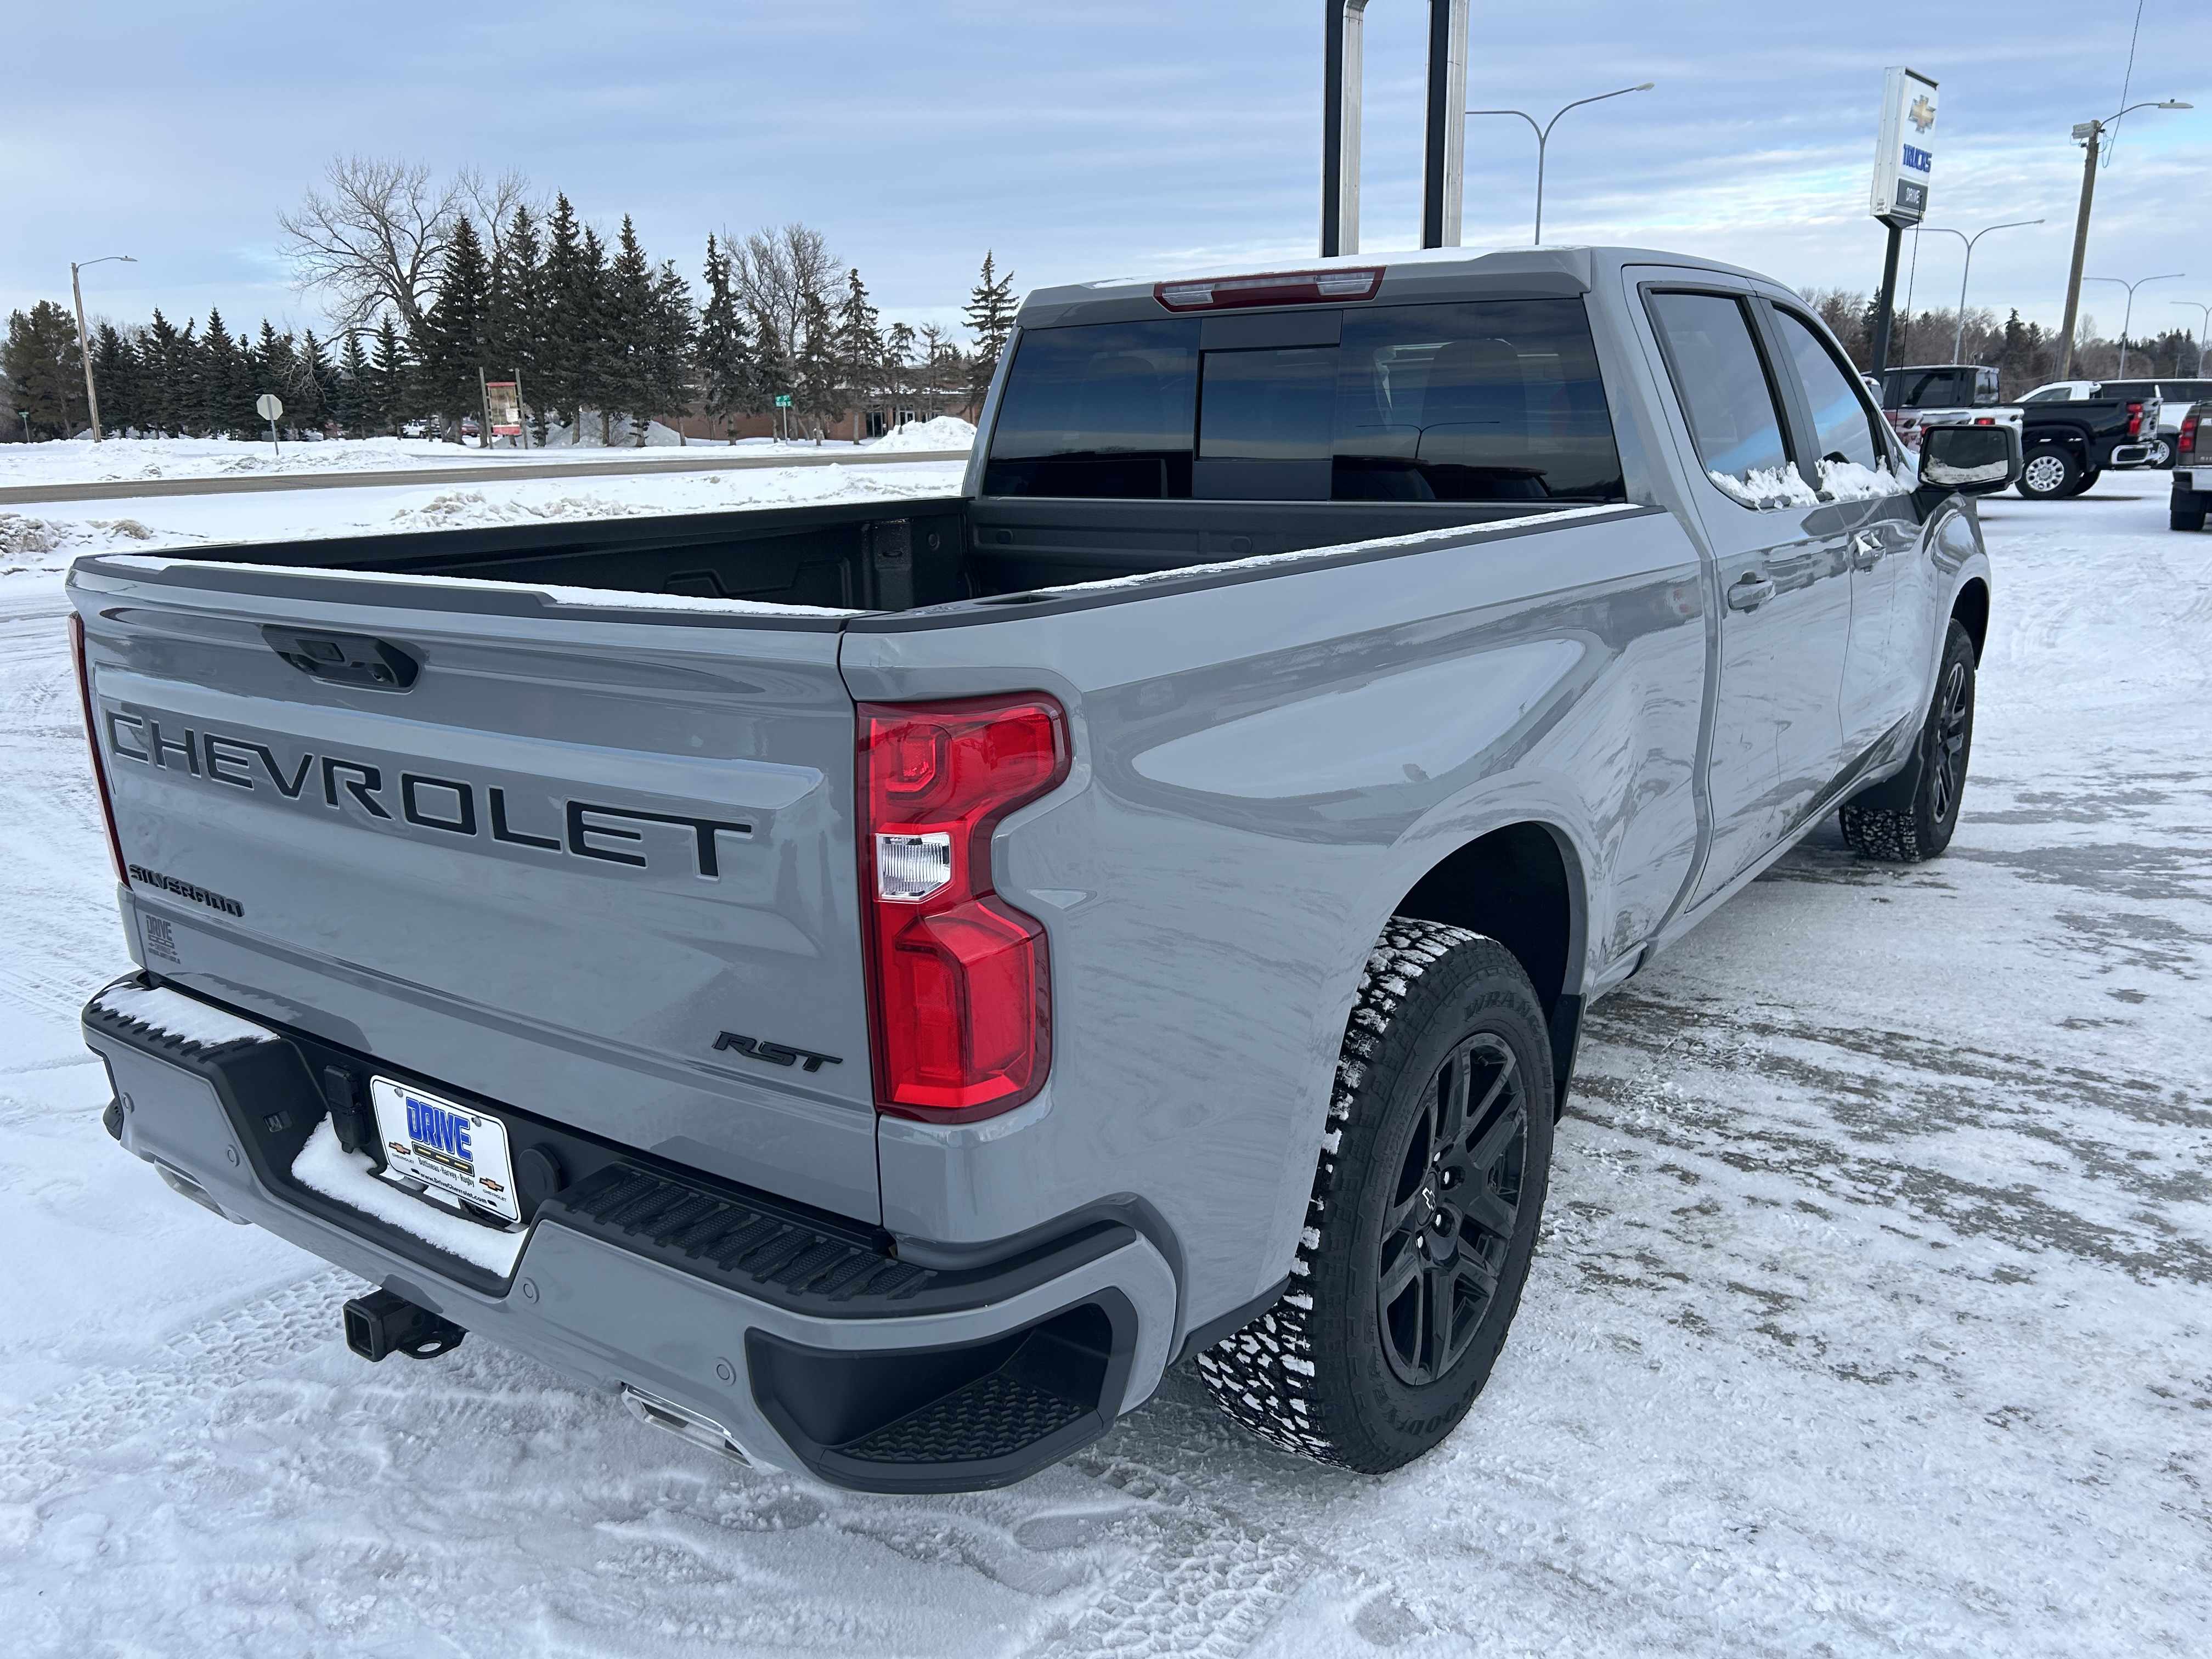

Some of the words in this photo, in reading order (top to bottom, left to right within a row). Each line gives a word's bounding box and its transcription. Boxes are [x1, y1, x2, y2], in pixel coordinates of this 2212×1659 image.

[1903, 143, 1932, 172] TRUCKS
[1905, 187, 1920, 204] DRIVE
[106, 710, 753, 881] CHEVROLET
[129, 864, 245, 917] SILVERADO
[146, 915, 172, 941] DRIVE
[712, 1031, 843, 1073] RST
[406, 1096, 473, 1162] DRIVE
